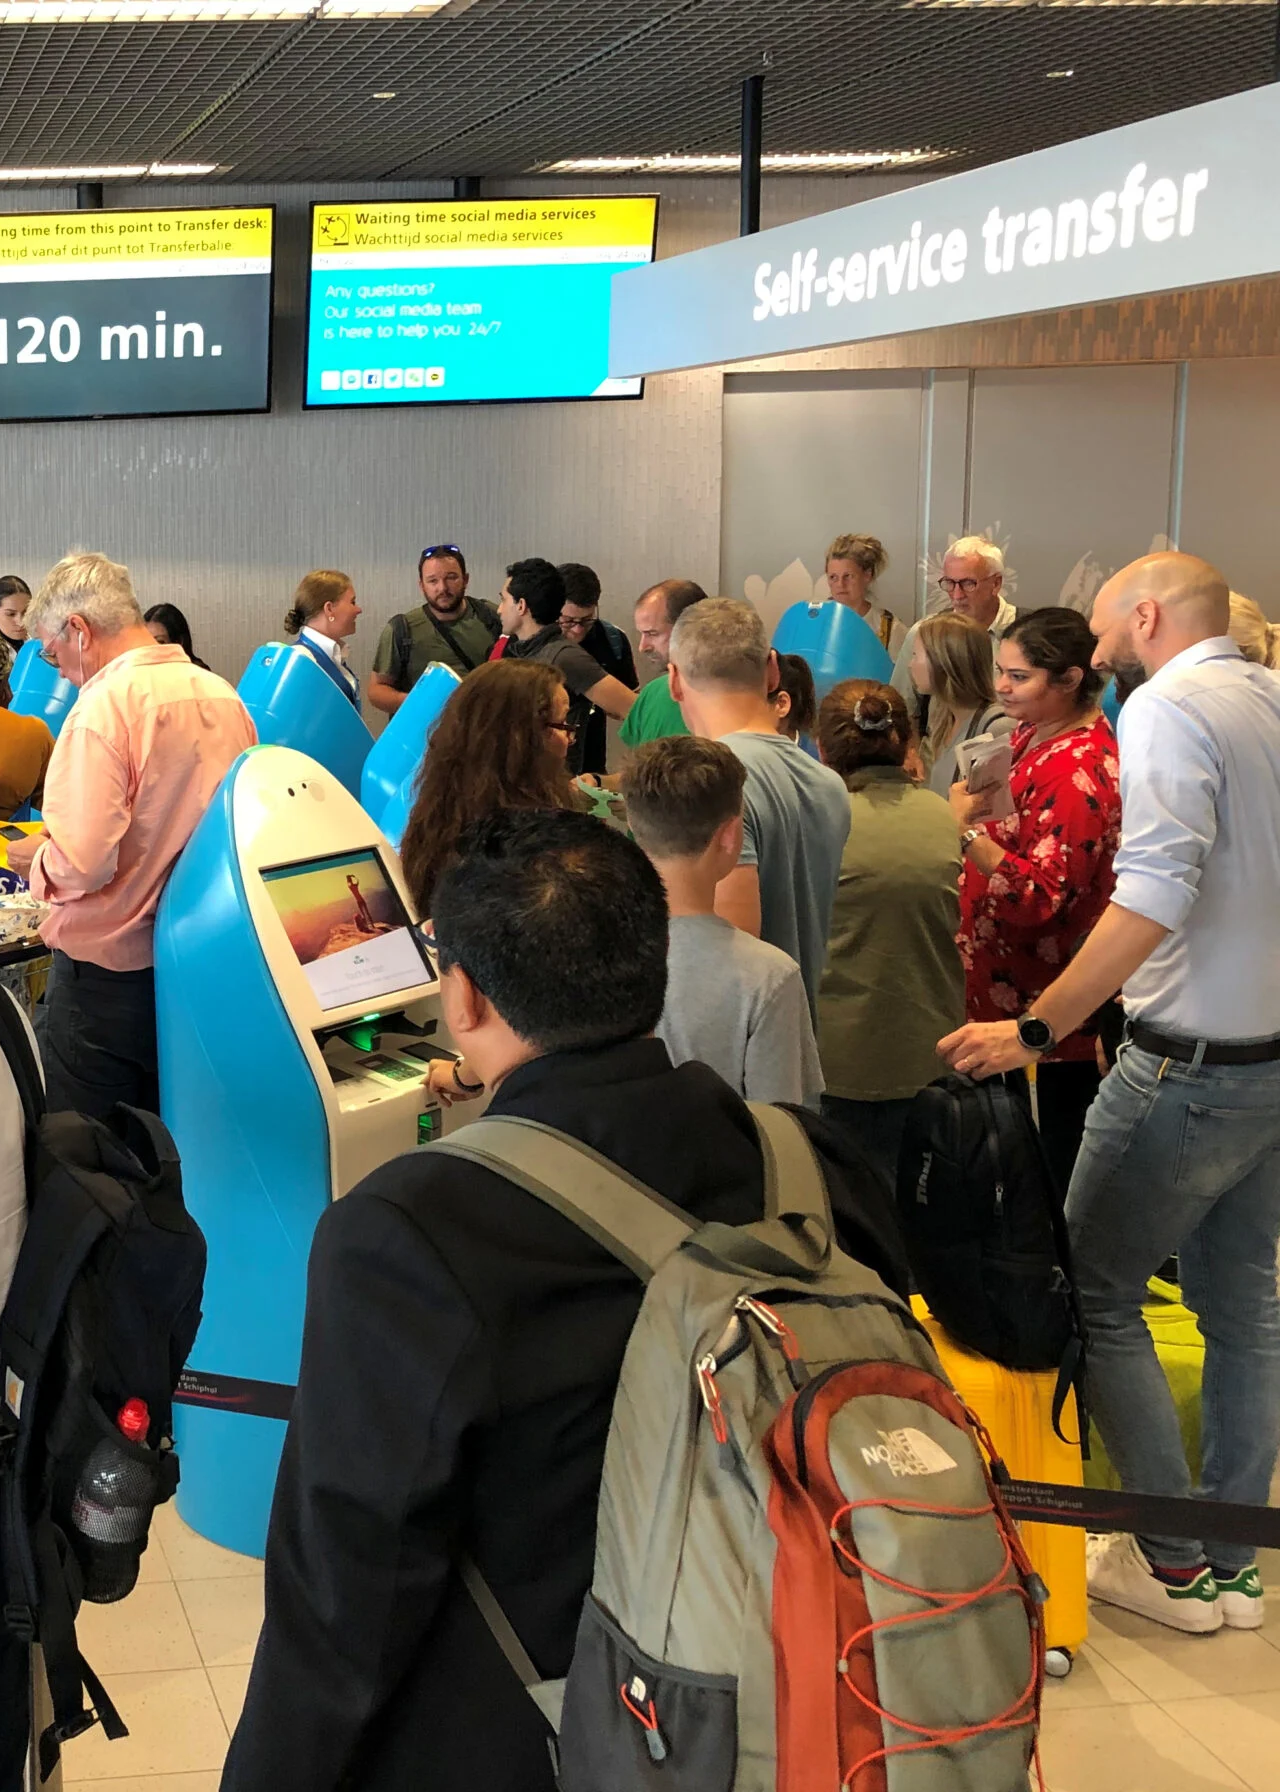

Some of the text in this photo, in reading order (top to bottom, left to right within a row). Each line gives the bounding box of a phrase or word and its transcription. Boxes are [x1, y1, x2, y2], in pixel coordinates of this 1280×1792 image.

[355, 208, 596, 225] Waiting time social media services
[22, 225, 50, 236] time
[55, 223, 86, 235] from
[91, 222, 114, 234] this
[119, 221, 153, 235] point
[158, 221, 171, 232] to
[176, 218, 228, 232] Transfer
[233, 218, 267, 230] desk:
[355, 229, 563, 246] Wachttijd social media services
[753, 161, 1209, 321] Self-service transfer
[32, 244, 67, 257] vanaf
[71, 244, 88, 256] dit
[92, 244, 122, 257] punt
[127, 243, 144, 254] tot
[325, 282, 435, 300] Any questions?
[324, 302, 482, 319] Our social media team
[100, 311, 222, 361] min.
[323, 321, 502, 340] is here to help you 24/7
[1000, 1483, 1055, 1497] msterdam
[1001, 1493, 1032, 1504] irport
